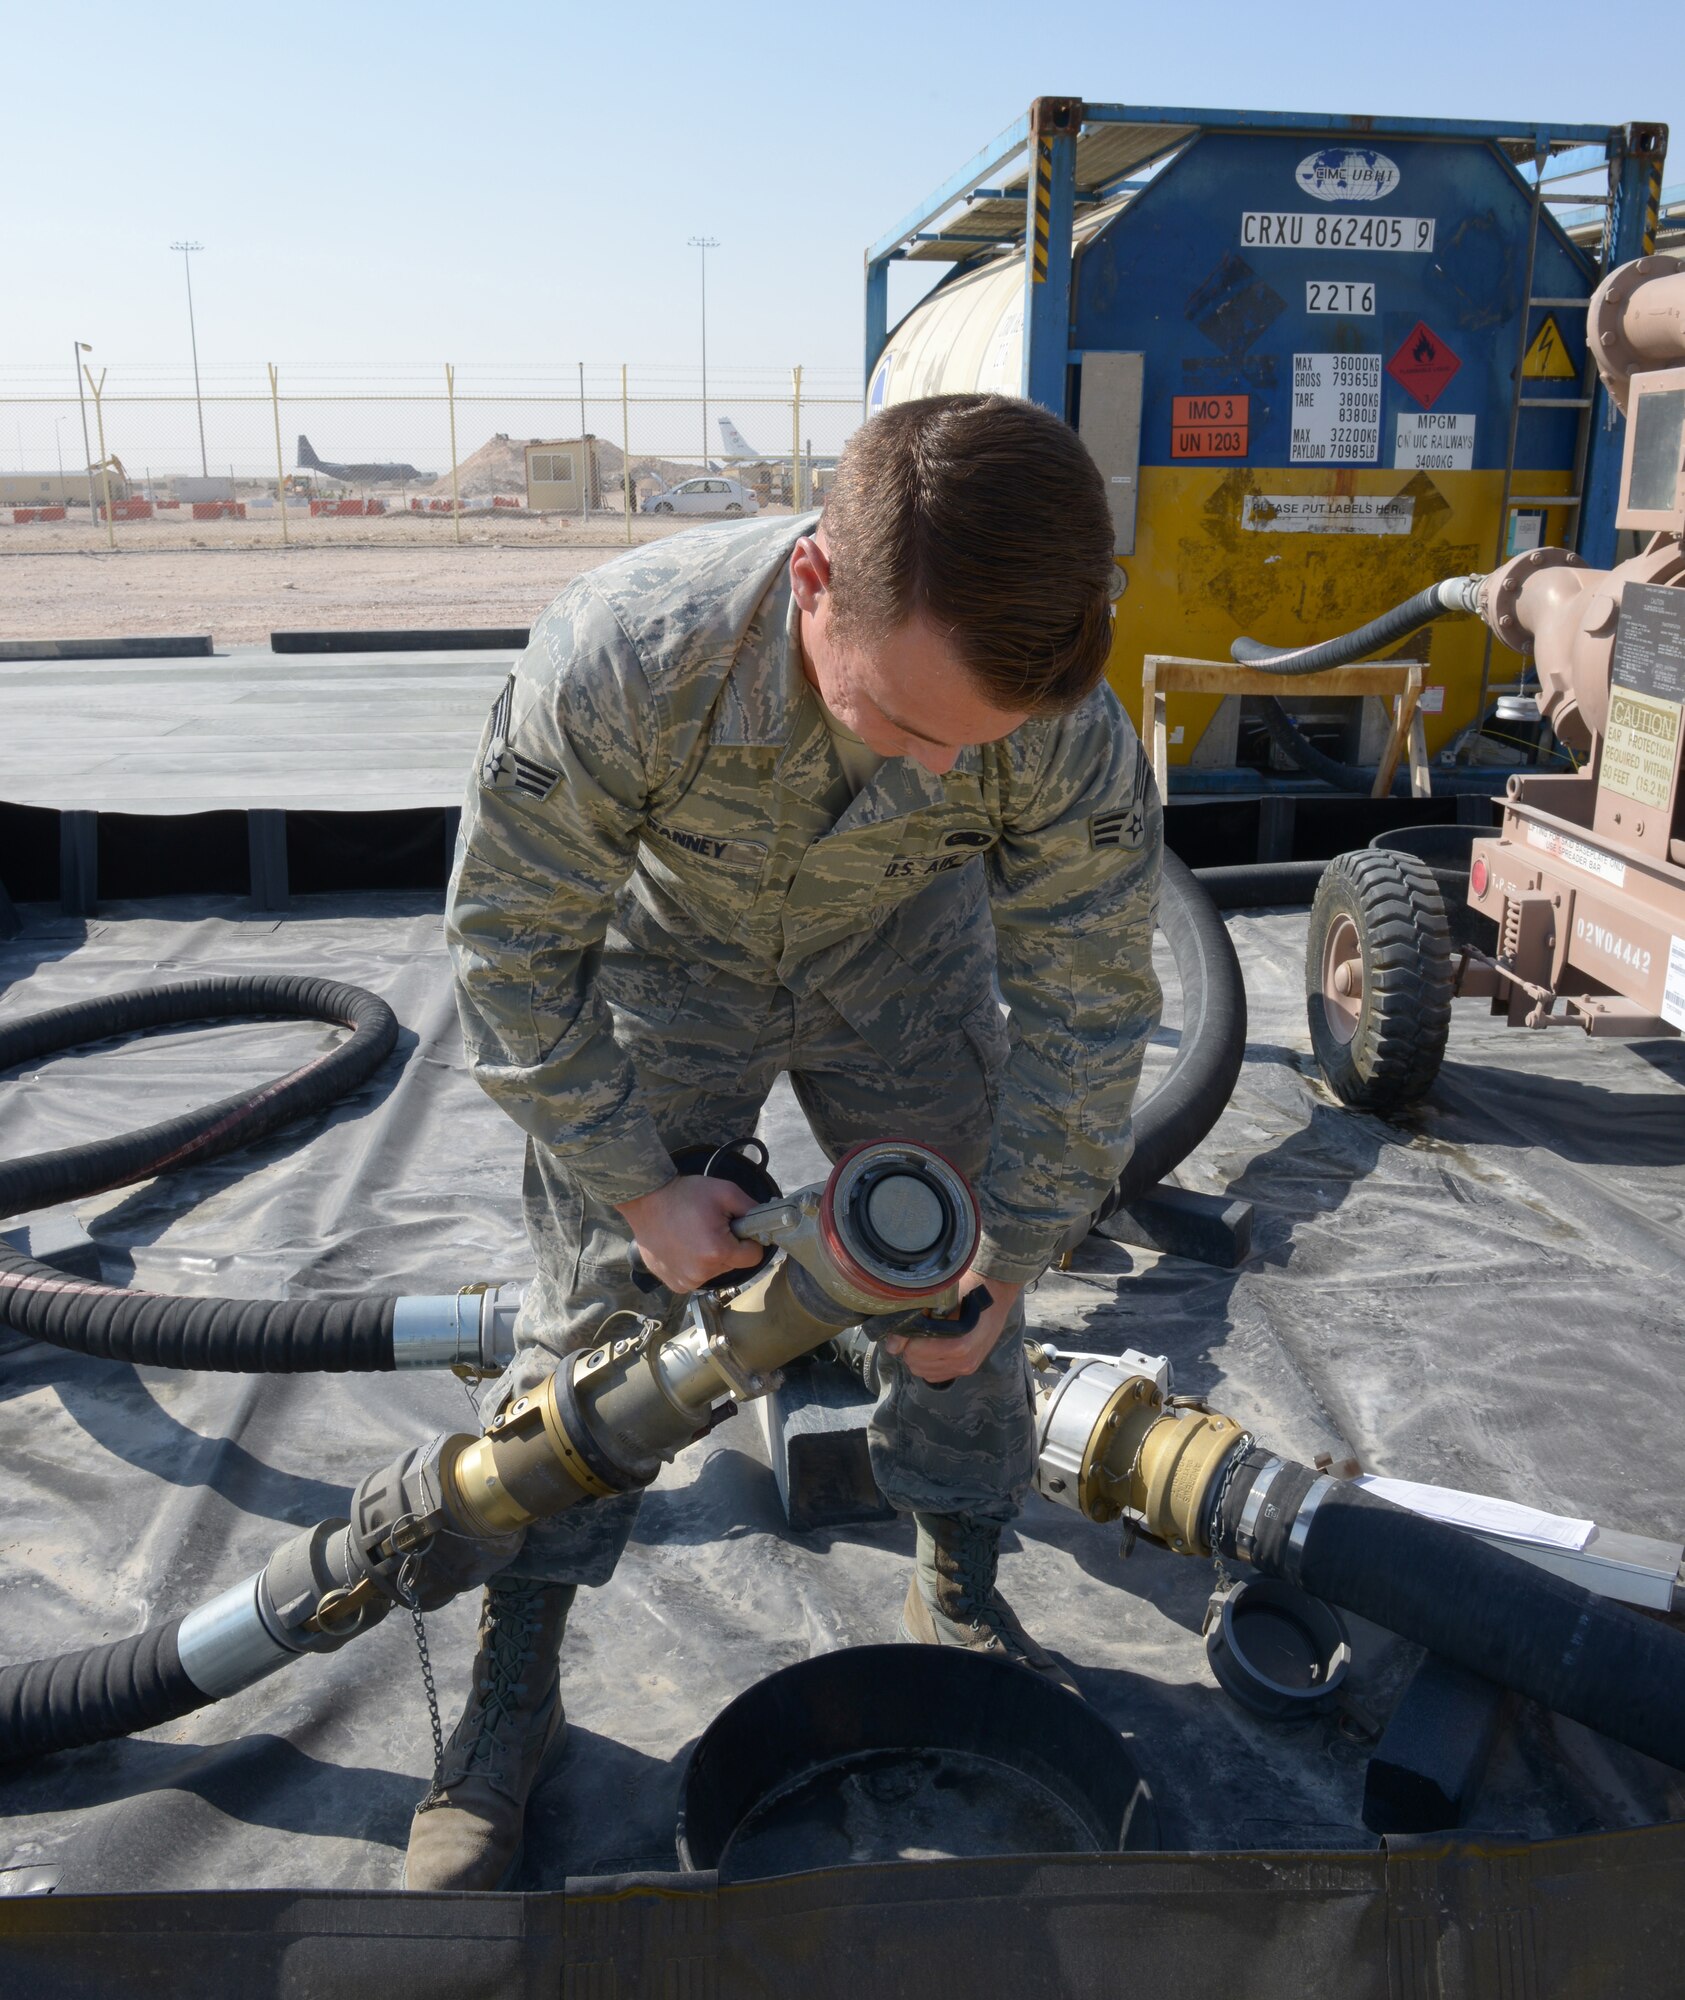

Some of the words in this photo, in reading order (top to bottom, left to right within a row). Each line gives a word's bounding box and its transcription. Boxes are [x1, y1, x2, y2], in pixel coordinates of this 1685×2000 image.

[1352, 169, 1394, 182] UBHI
[1244, 215, 1303, 244] CRXU
[1315, 217, 1402, 248] 862405
[1417, 221, 1430, 248] 9
[1309, 284, 1373, 312] 22T6
[1295, 357, 1312, 372] MAX
[1295, 372, 1321, 387] GROSS
[1295, 393, 1314, 407] TARE
[1189, 401, 1220, 419] IMO
[1224, 400, 1233, 419] 3
[1418, 414, 1456, 429] MPGM
[1180, 433, 1200, 452] UN
[1208, 432, 1240, 452] 1203
[1293, 428, 1310, 443] MAX
[1413, 434, 1428, 448] UIC
[1431, 434, 1473, 449] RAILWAYS
[1292, 444, 1326, 458] PAYLOAD
[1416, 454, 1453, 469] 34000KG
[1302, 504, 1326, 514] PUT
[1328, 504, 1372, 514] LABELS
[1614, 702, 1673, 739] CAUTION
[1607, 726, 1622, 742] EAR
[1628, 734, 1673, 760] PROTECTION
[1605, 745, 1640, 769] REQUIRED
[1644, 760, 1672, 781] WITHIN
[1602, 764, 1612, 779] 50
[1613, 768, 1630, 786] FEET
[1546, 842, 1557, 852] USE
[1558, 846, 1588, 866] SPREADER
[1588, 860, 1602, 871] BAR
[884, 862, 914, 877] U.S.
[1576, 918, 1651, 976] 02W04442
